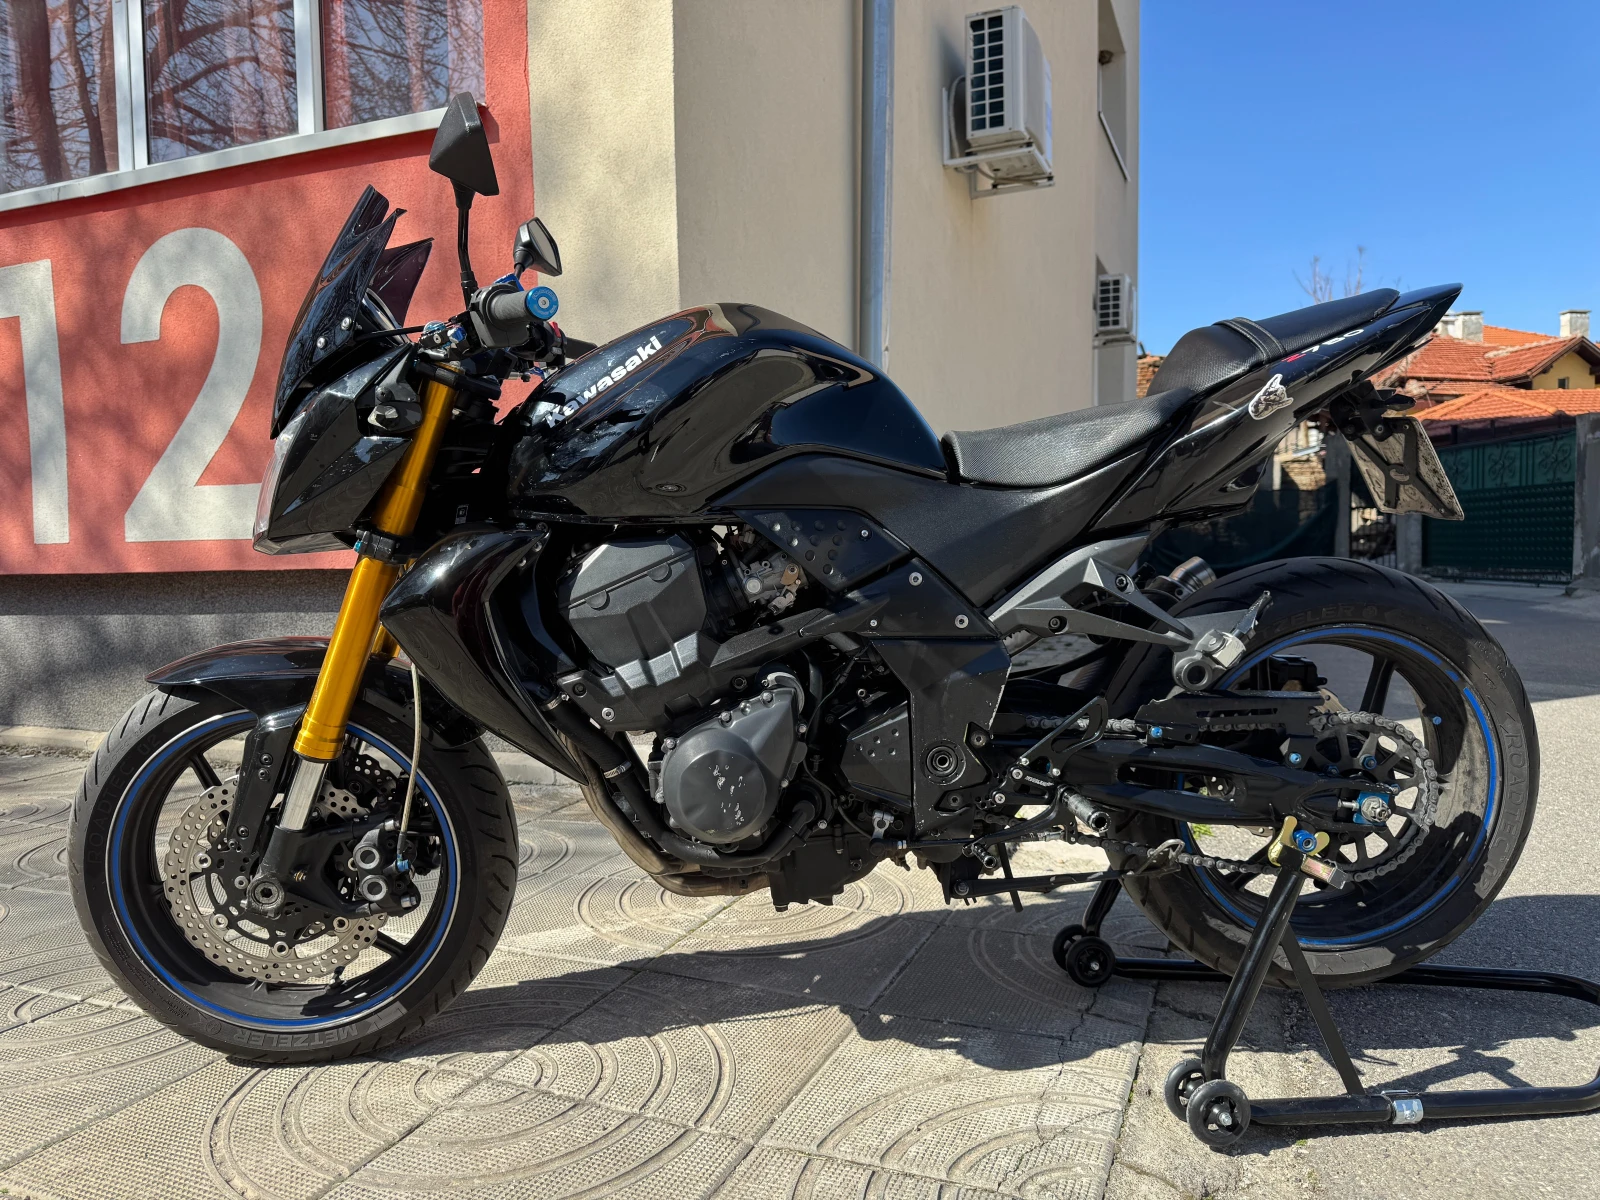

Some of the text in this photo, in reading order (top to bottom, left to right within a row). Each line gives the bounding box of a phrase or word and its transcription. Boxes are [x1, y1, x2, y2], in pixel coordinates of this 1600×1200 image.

[0, 227, 263, 544] 12
[544, 336, 663, 429] Kawasaki
[233, 1023, 360, 1048] METZELER
